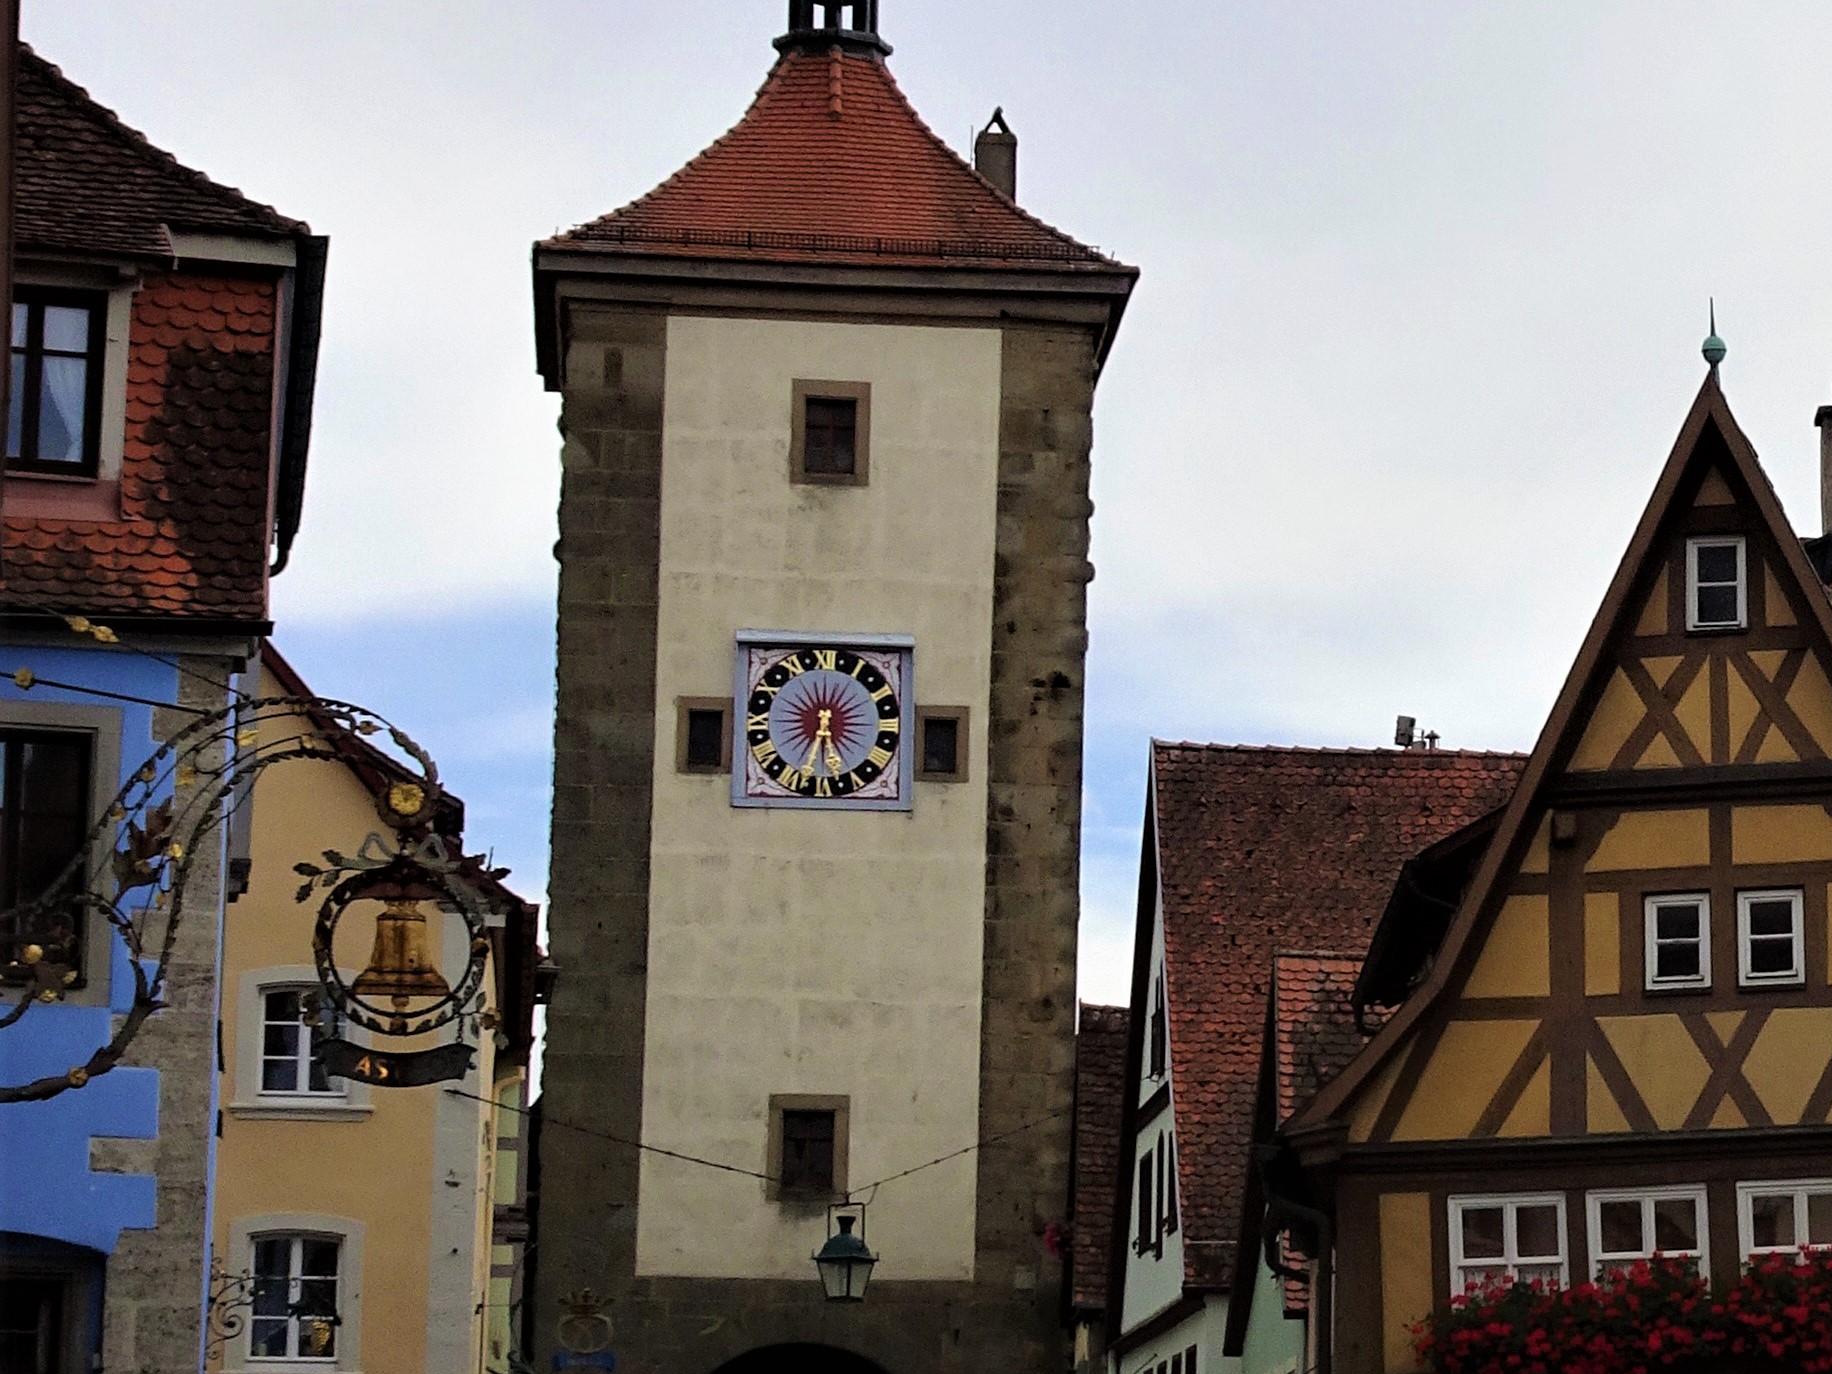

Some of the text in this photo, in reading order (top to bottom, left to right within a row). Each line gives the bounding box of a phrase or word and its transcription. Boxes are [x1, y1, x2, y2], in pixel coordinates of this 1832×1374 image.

[813, 650, 838, 670] XII
[871, 683, 893, 703] II
[878, 716, 900, 734] III
[814, 777, 833, 797] VI
[850, 771, 867, 789] V
